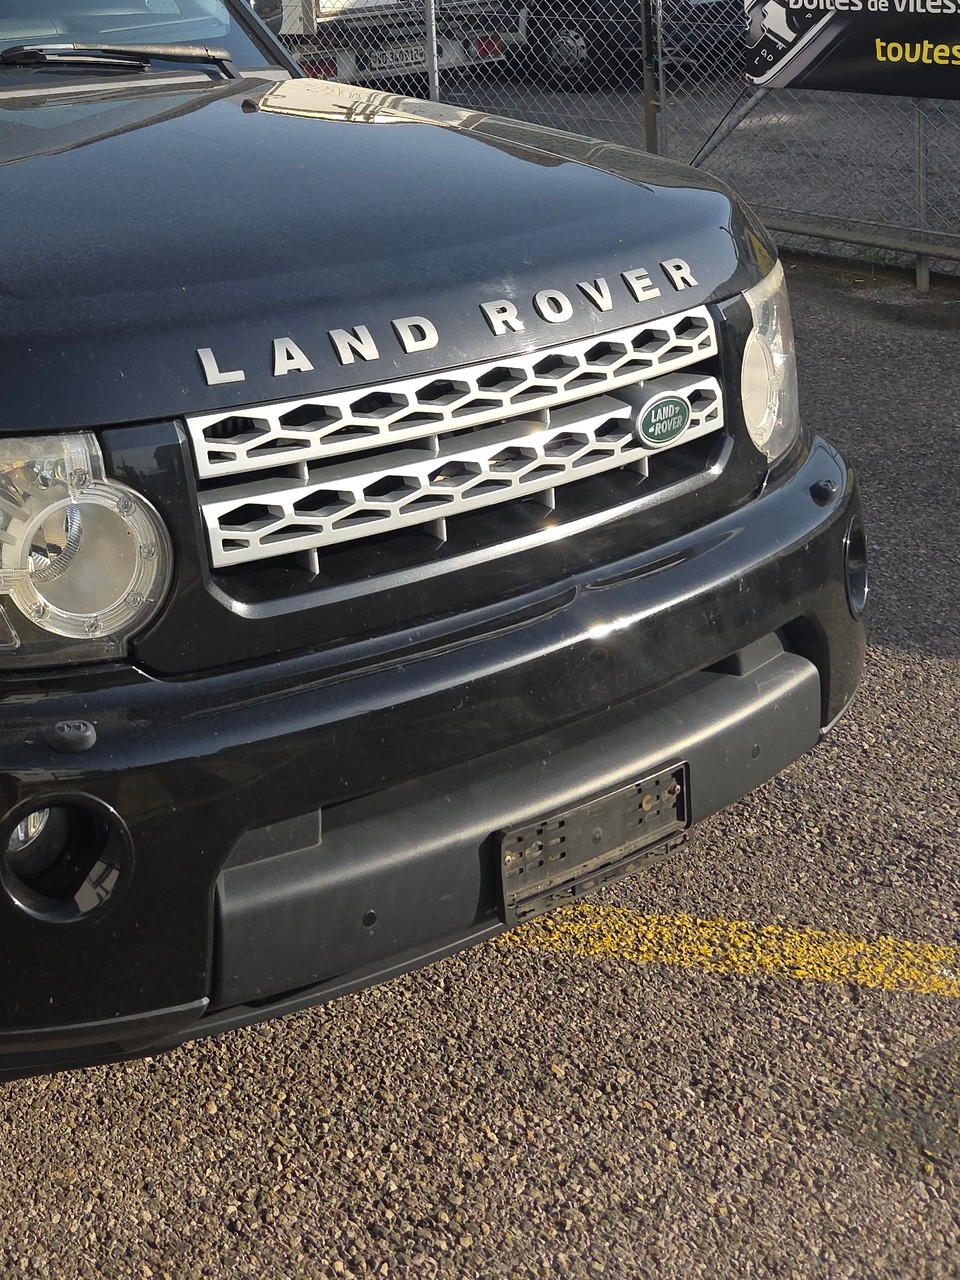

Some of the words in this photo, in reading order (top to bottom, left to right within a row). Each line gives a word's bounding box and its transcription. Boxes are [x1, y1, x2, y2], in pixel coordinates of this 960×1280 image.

[196, 316, 439, 386] LAND
[480, 257, 699, 336] ROVER
[651, 404, 675, 423] LAND
[654, 414, 683, 436] ROVER
